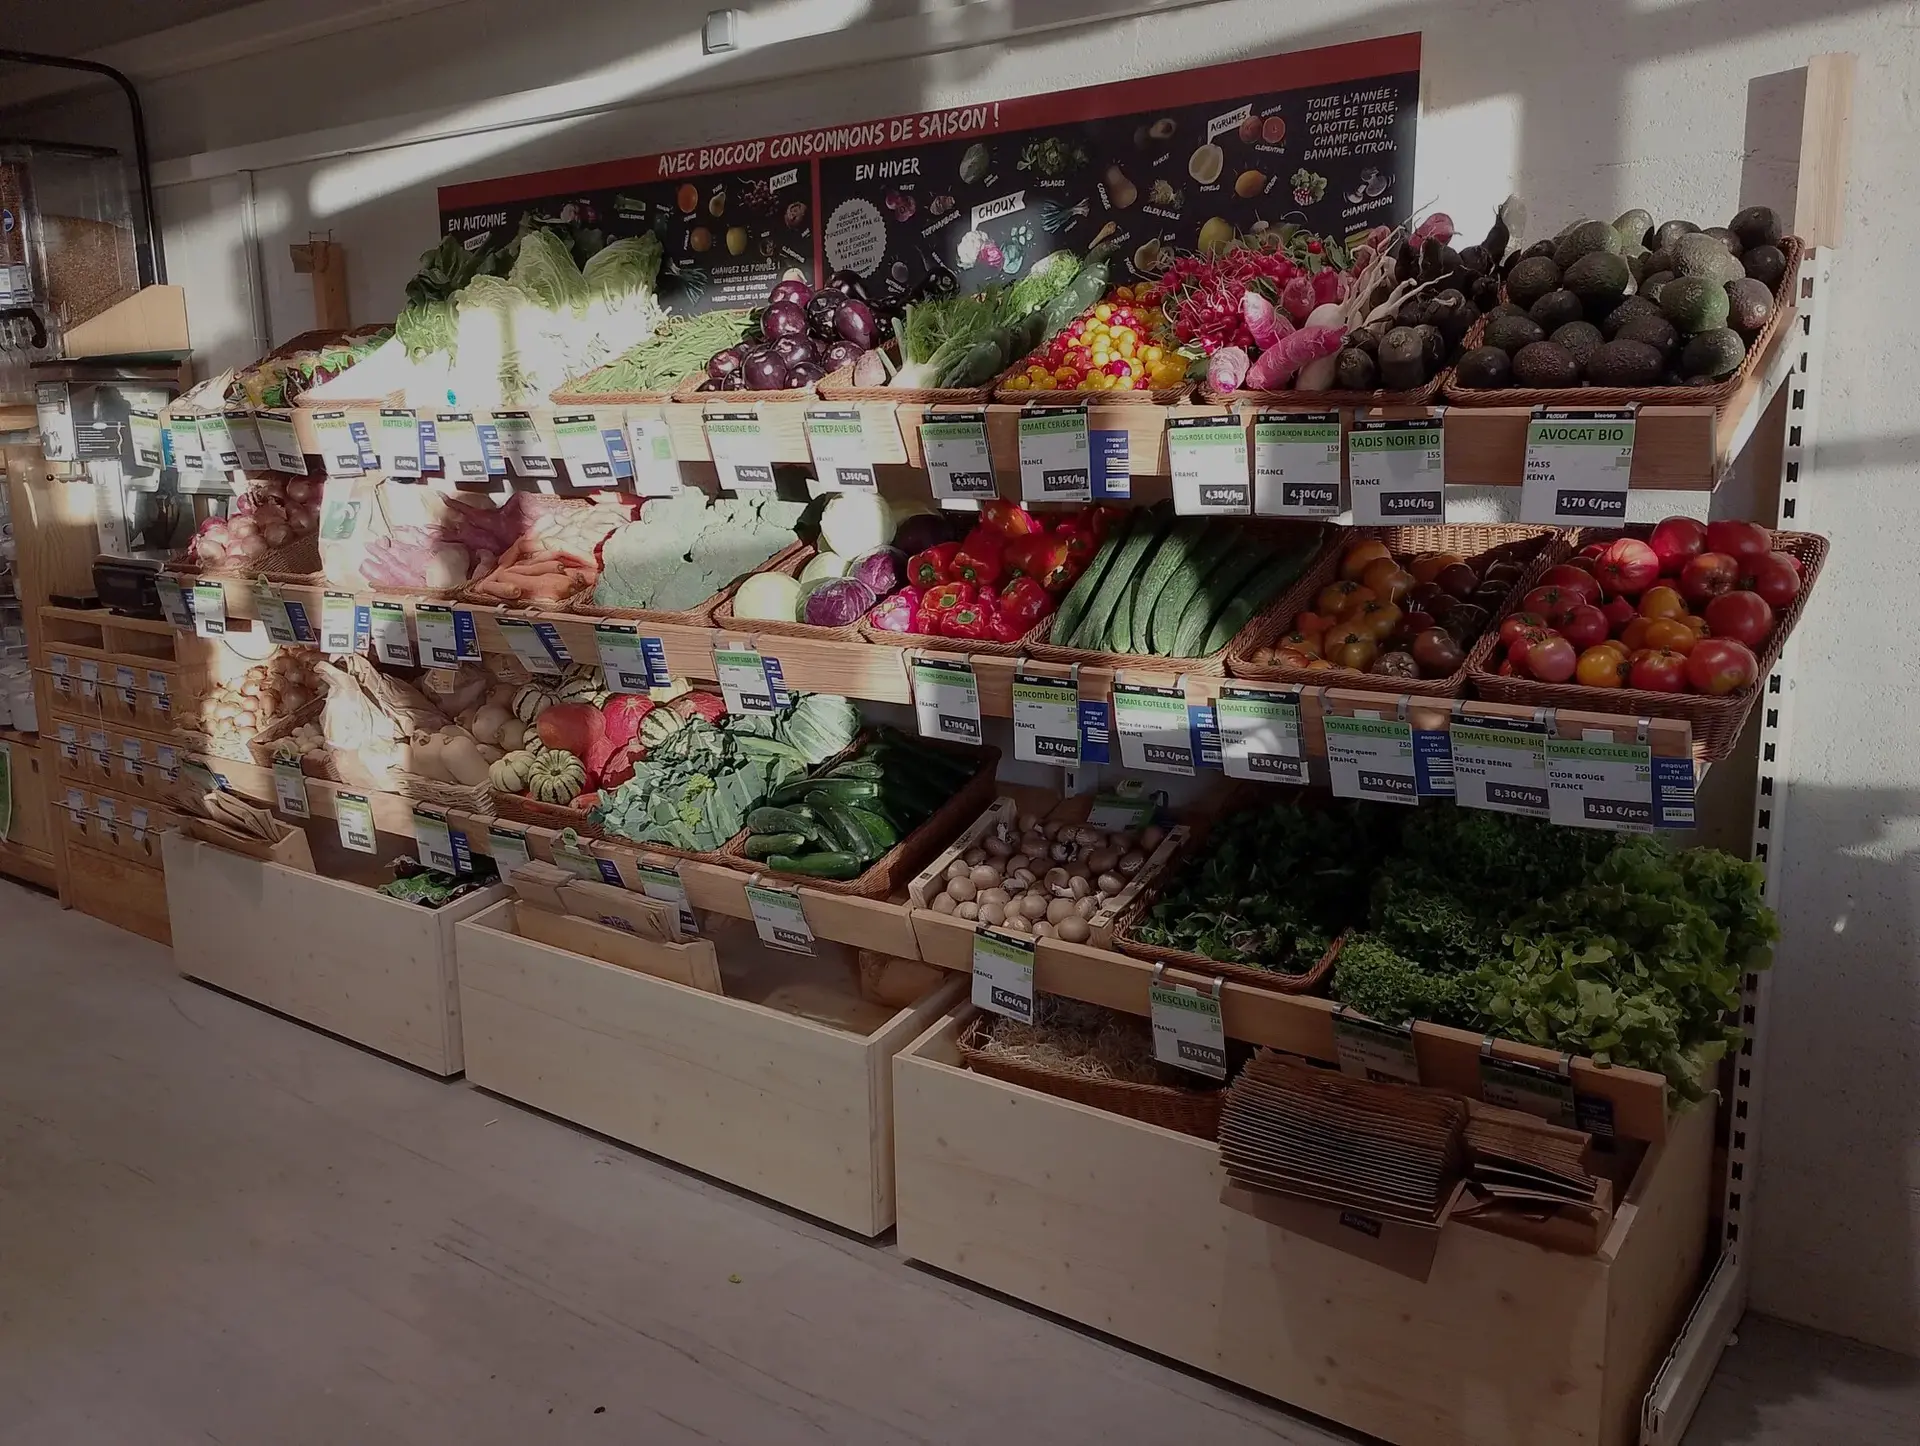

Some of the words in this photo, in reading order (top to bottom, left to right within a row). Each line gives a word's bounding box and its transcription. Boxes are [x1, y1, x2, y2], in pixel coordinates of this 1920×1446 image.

[1307, 94, 1339, 111] TOUTE
[1343, 85, 1391, 105] L'ANNÉE
[1305, 107, 1342, 123] POMME
[1345, 105, 1359, 118] DE
[1361, 99, 1399, 116] TERRE,
[1210, 110, 1247, 132] AGRUMES
[1309, 118, 1360, 136] CAROTTE,
[1362, 113, 1395, 129] RADIS
[658, 153, 695, 178] AVEC
[699, 141, 764, 170] BIOCOOP
[770, 121, 886, 165] CONSOMMONS
[890, 118, 913, 141] DE
[918, 105, 988, 139] SAISON
[993, 102, 1000, 126] !
[1313, 129, 1388, 147] CHAMPIGNON,
[1303, 145, 1352, 161] BANANE,
[1354, 140, 1398, 155] CITRON,
[854, 164, 875, 182] EN
[878, 156, 921, 179] HIVER
[772, 173, 794, 187] RAISIN
[1040, 179, 1066, 188] SALADES
[1096, 182, 1113, 211] COURGE
[978, 196, 1016, 219] CHOUX
[1341, 194, 1394, 219] CHAMPIGNON
[447, 216, 461, 232] EN
[462, 210, 507, 231] AUTOMNE
[836, 216, 860, 229] PRODUITS
[862, 219, 873, 228] PAR
[849, 231, 871, 243] BIOCOOP
[711, 265, 740, 276] CHANGEZ
[741, 264, 750, 273] DE
[708, 425, 747, 433] AUBERGINE
[748, 424, 760, 433] BIO
[849, 424, 862, 433] BIO
[1021, 421, 1046, 431] OMATE
[1047, 419, 1071, 429] CERISE
[1071, 419, 1085, 427] BIO
[1189, 433, 1205, 441] ROSE
[1233, 432, 1245, 440] BIO
[1303, 429, 1326, 437] BLANC
[1327, 429, 1339, 437] BIO
[1538, 427, 1594, 441] AVOCAT
[1598, 428, 1623, 441] BIO
[1351, 434, 1383, 448] RADIS
[1386, 433, 1416, 446] NOIR
[1418, 433, 1440, 445] BIO
[1620, 447, 1632, 456] 27
[1527, 460, 1551, 468] HASS
[1257, 468, 1284, 476] FRANCE
[1526, 473, 1555, 482] KENYA
[1047, 475, 1086, 485] 13,95€/kg
[1352, 478, 1380, 486] FRANCE
[1205, 489, 1244, 502] 4,30€/kg
[1289, 489, 1333, 502] 4,30€/kg
[1387, 498, 1435, 511] 4,30€/kg
[1588, 497, 1622, 510] €/pce
[1014, 688, 1059, 701] concombre
[1060, 691, 1076, 702] BIO
[919, 701, 939, 709] FRANCE
[1115, 697, 1141, 707] TOMATE
[1172, 703, 1186, 711] BIO
[1281, 709, 1295, 717] BIO
[1015, 721, 1037, 730] FRANCE
[1325, 721, 1360, 732] TOMATE
[1361, 723, 1392, 734] RONDE
[1394, 726, 1410, 736] BIO
[1119, 730, 1143, 738] FRANCE
[1453, 730, 1491, 742] TOMATE
[1492, 734, 1525, 746] RONDE
[1528, 737, 1545, 748] BIO
[1222, 737, 1247, 746] FRANCE
[1398, 741, 1412, 749] 250
[1055, 743, 1076, 755] €/pce
[1328, 745, 1355, 756] Orange
[1355, 749, 1378, 758] queen
[1546, 744, 1586, 755] TOMATE
[1631, 749, 1649, 760] BIO
[1166, 751, 1190, 762] €/pce
[1329, 756, 1358, 764] FRANCE
[1454, 755, 1477, 764] ROSE
[1478, 757, 1487, 765] DE
[1487, 759, 1513, 769] BERNE
[1273, 759, 1299, 771] €/pce
[1455, 765, 1486, 775] FRANCE
[1634, 764, 1650, 773] 250
[1549, 771, 1577, 780] CUOR
[1580, 773, 1605, 782] ROUGE
[1385, 778, 1413, 790] €/pce
[1550, 781, 1584, 791] FRANCE
[1493, 788, 1542, 804] 8,30€/kg
[1588, 803, 1613, 815] 8,30
[1616, 805, 1649, 818] €/pce
[973, 969, 993, 980] FRANCE
[1152, 992, 1198, 1010] MESCLUN
[1200, 1003, 1218, 1014] BIO
[1154, 1023, 1177, 1034] FRANCE
[1182, 1045, 1222, 1062] 15,75€/kg
